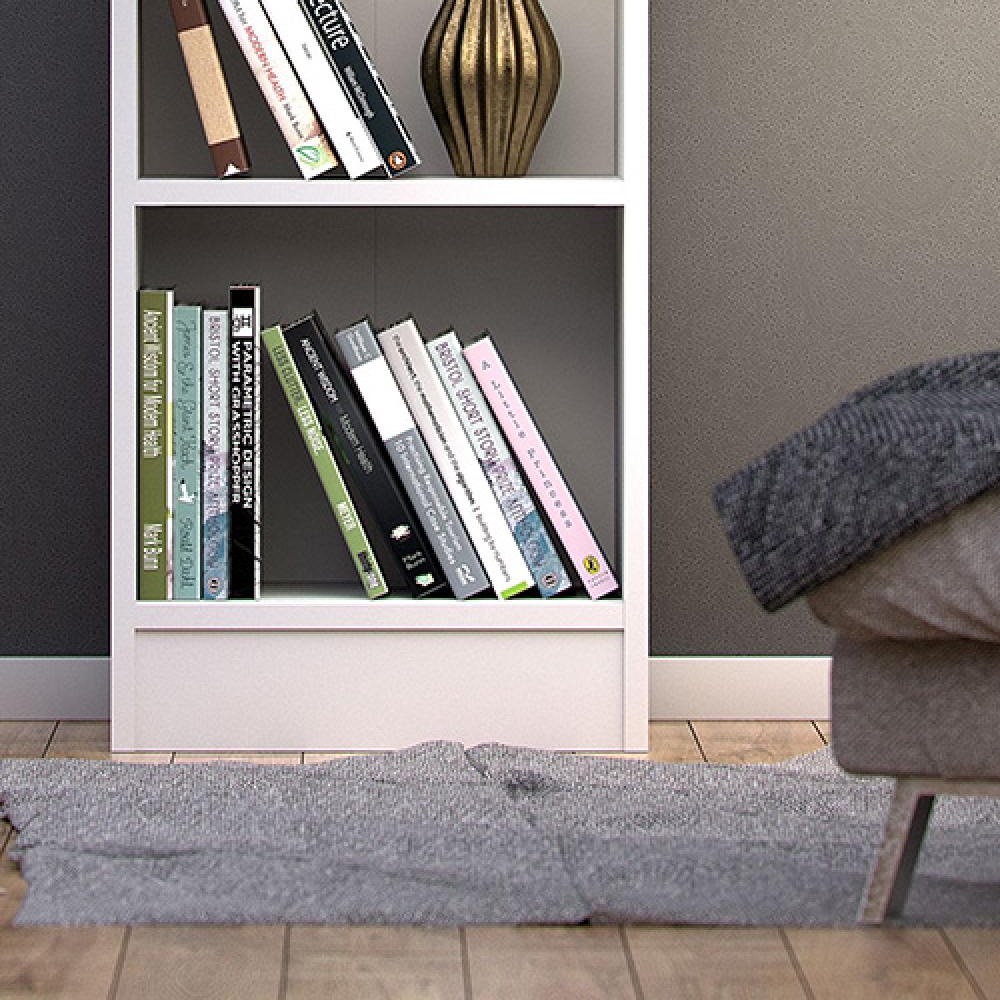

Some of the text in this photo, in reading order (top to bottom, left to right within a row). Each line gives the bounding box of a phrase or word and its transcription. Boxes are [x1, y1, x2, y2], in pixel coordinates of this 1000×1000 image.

[244, 26, 270, 68] MODERN
[266, 68, 286, 102] HEALTH
[208, 315, 220, 363] BRISTOL
[208, 367, 220, 407] SHORT
[318, 370, 338, 402] WISDOM
[434, 342, 464, 386] BRISTOL
[456, 388, 482, 424] SHORT
[143, 310, 162, 570] Ancient Wisdom for Modern Health Mark Bunn
[205, 411, 220, 453] STORY
[231, 340, 240, 503] WITH GRASSHOPPER
[242, 340, 252, 508] PARAMETRIC DESIGN
[179, 517, 193, 552] Roald
[179, 555, 195, 588] Dahl
